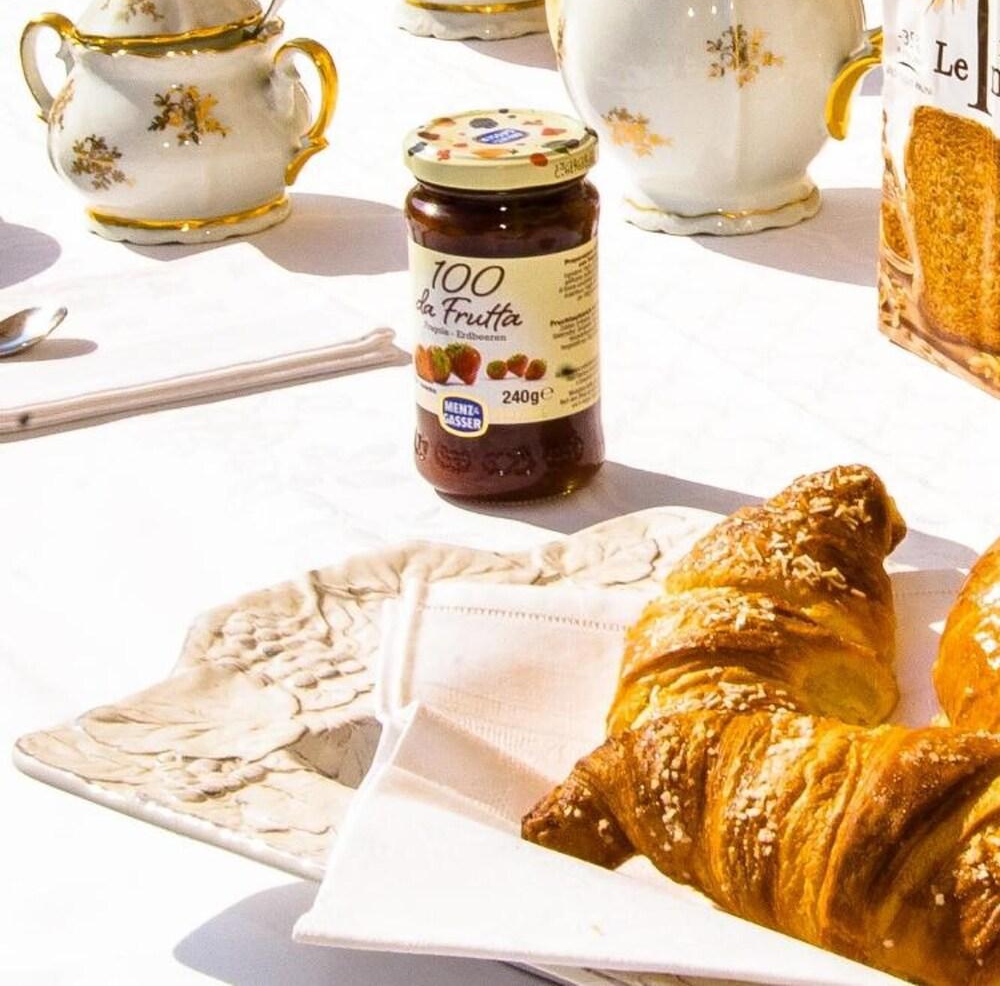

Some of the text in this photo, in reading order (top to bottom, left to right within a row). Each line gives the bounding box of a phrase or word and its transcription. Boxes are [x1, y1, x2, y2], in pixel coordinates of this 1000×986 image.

[933, 40, 969, 81] Le
[432, 260, 505, 297] 100
[416, 288, 437, 317] da
[441, 296, 523, 331] Frutta
[502, 389, 540, 405] 240g
